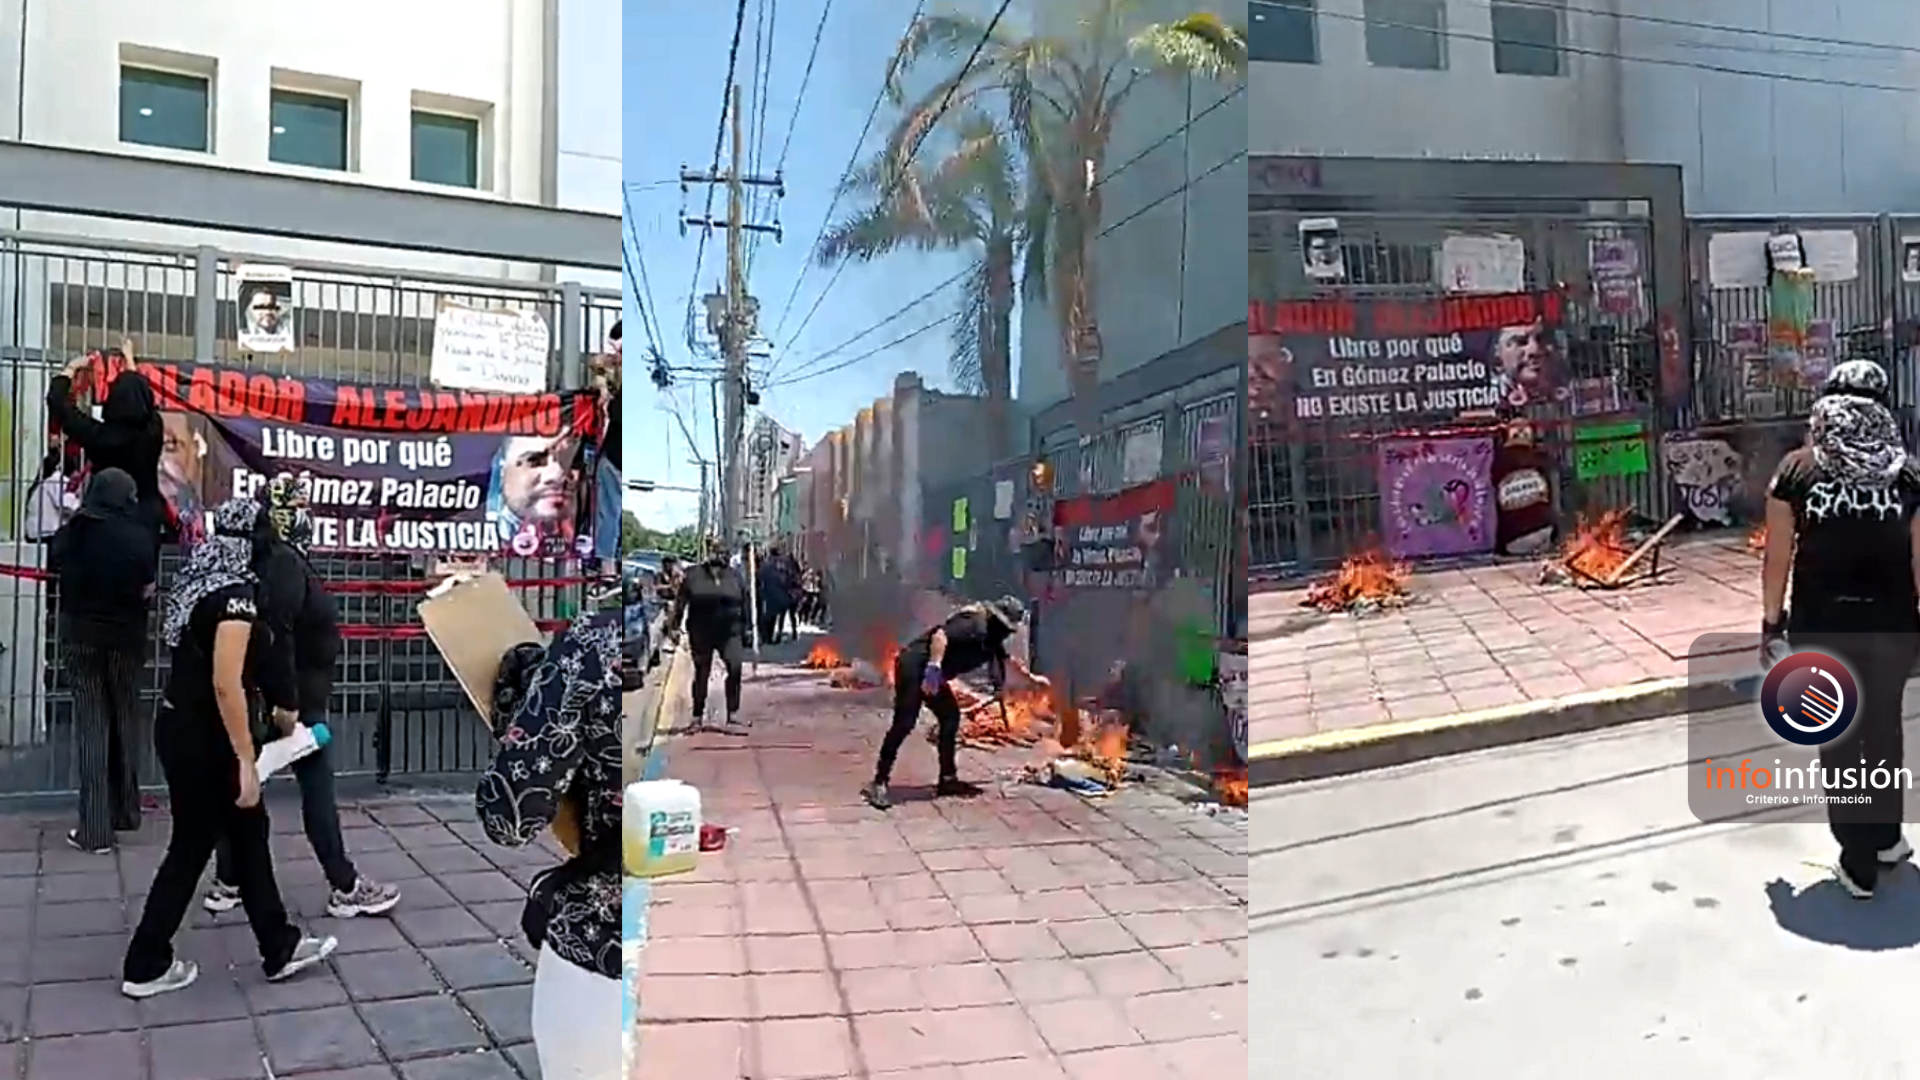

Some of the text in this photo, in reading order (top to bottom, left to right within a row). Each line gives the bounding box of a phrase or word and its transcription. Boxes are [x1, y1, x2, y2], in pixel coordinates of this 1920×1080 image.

[1329, 331, 1463, 360] Libre por qué
[1312, 359, 1486, 388] En Gómez Palacio
[331, 386, 562, 435] ALEJANDRO
[1295, 384, 1501, 418] NO EXISTE LA JUSTICIA
[261, 427, 452, 470] Libre por qué
[379, 477, 481, 509] Palacio
[347, 517, 378, 547] LA
[384, 518, 500, 551] JUSTICIA
